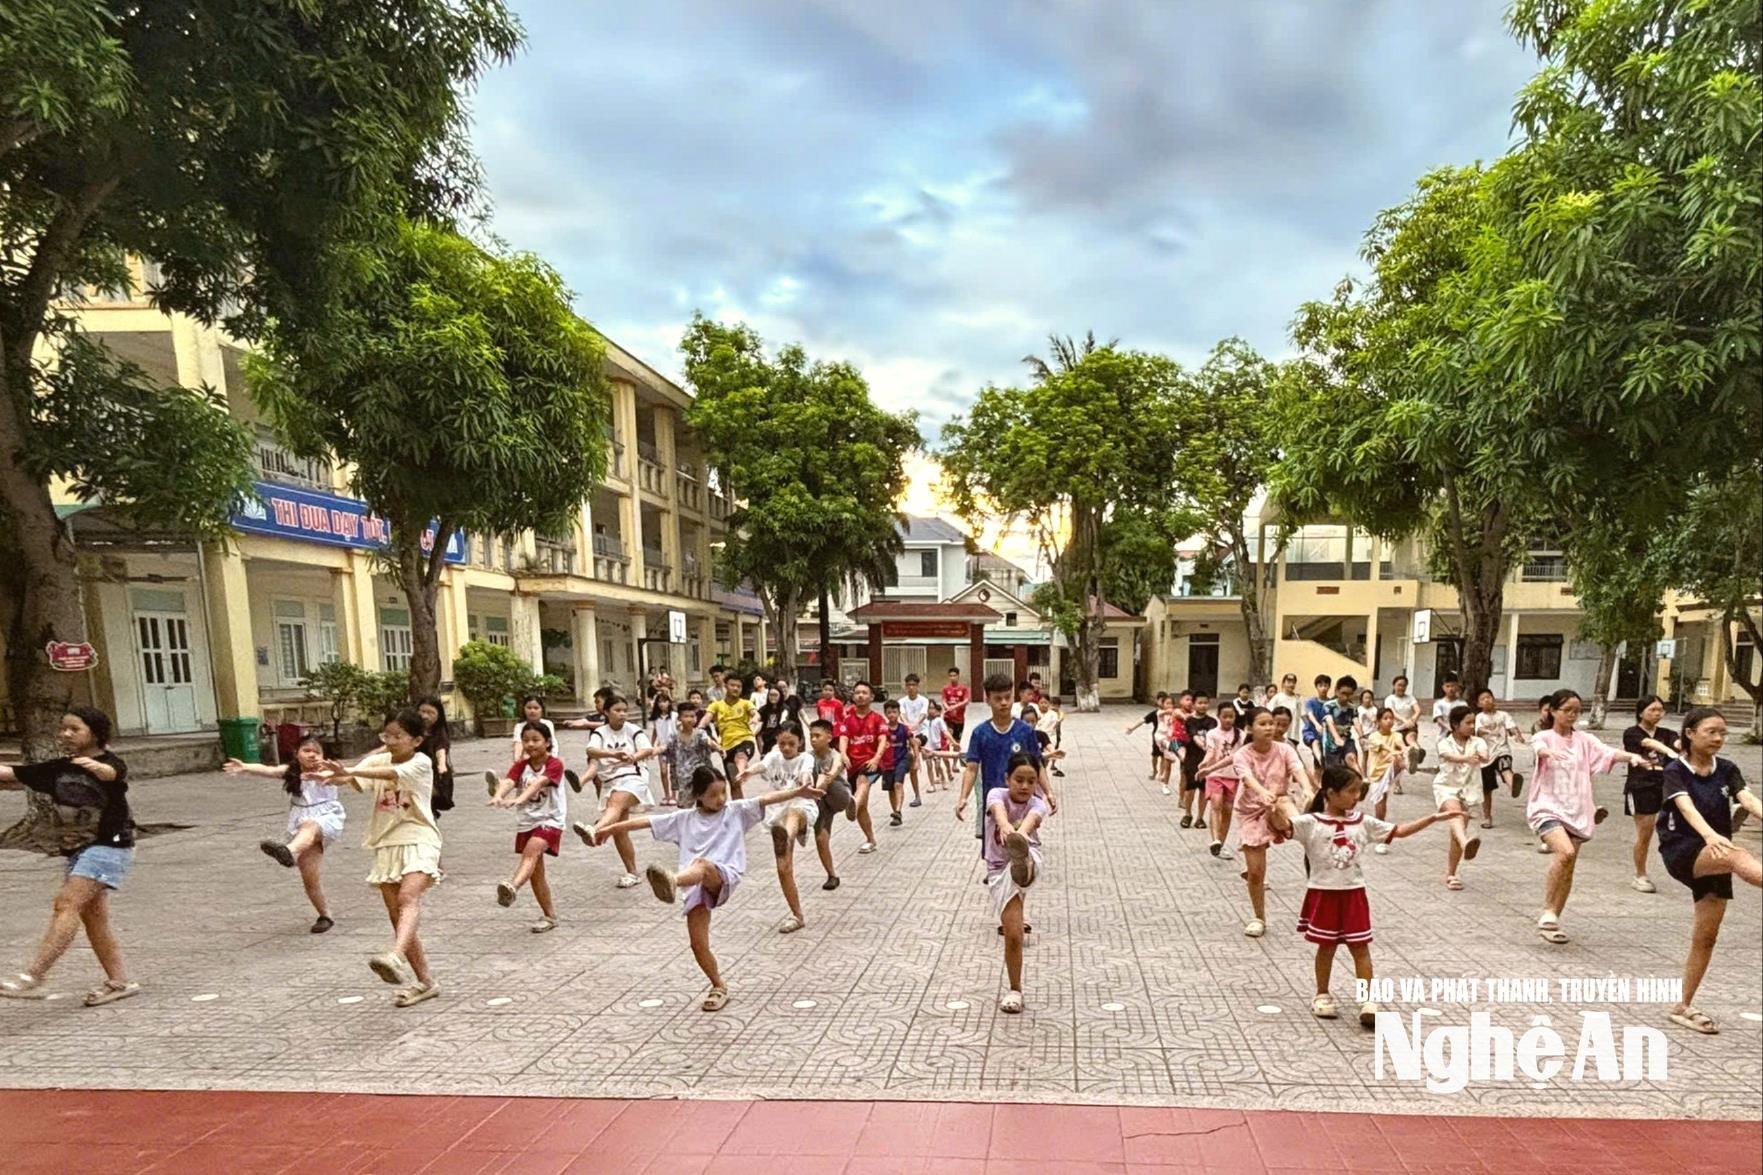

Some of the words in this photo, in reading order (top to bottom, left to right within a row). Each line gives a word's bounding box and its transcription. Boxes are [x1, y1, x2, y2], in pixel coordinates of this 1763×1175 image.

[271, 498, 299, 528] THI
[299, 503, 331, 533] ĐUA
[331, 509, 360, 541] DẠY
